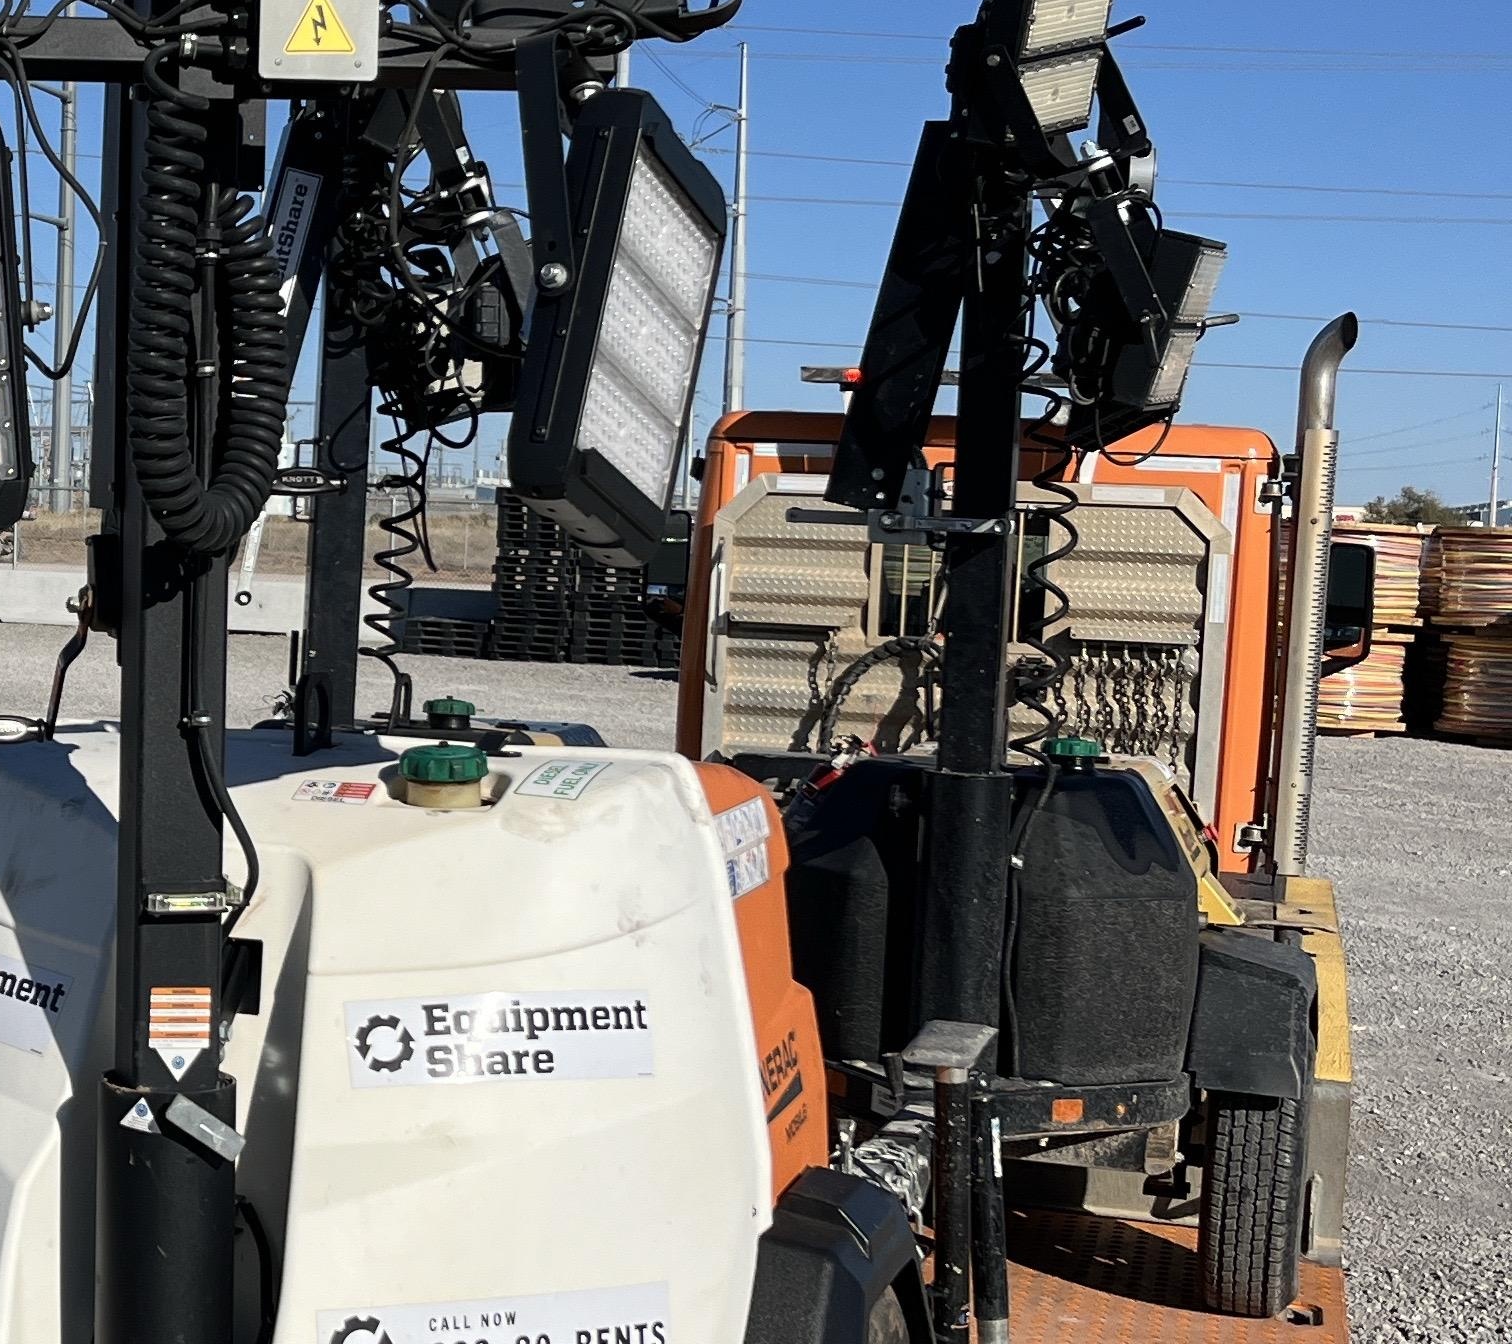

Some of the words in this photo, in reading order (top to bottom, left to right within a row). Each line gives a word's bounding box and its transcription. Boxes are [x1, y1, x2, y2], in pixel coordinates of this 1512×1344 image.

[533, 764, 570, 786] DIESEL
[553, 775, 584, 796] FUEL
[421, 999, 649, 1041] Equipment
[426, 1044, 555, 1079] Share
[759, 1030, 799, 1098] NERAC
[428, 1316, 472, 1333] CALL
[480, 1310, 518, 1330] NOW
